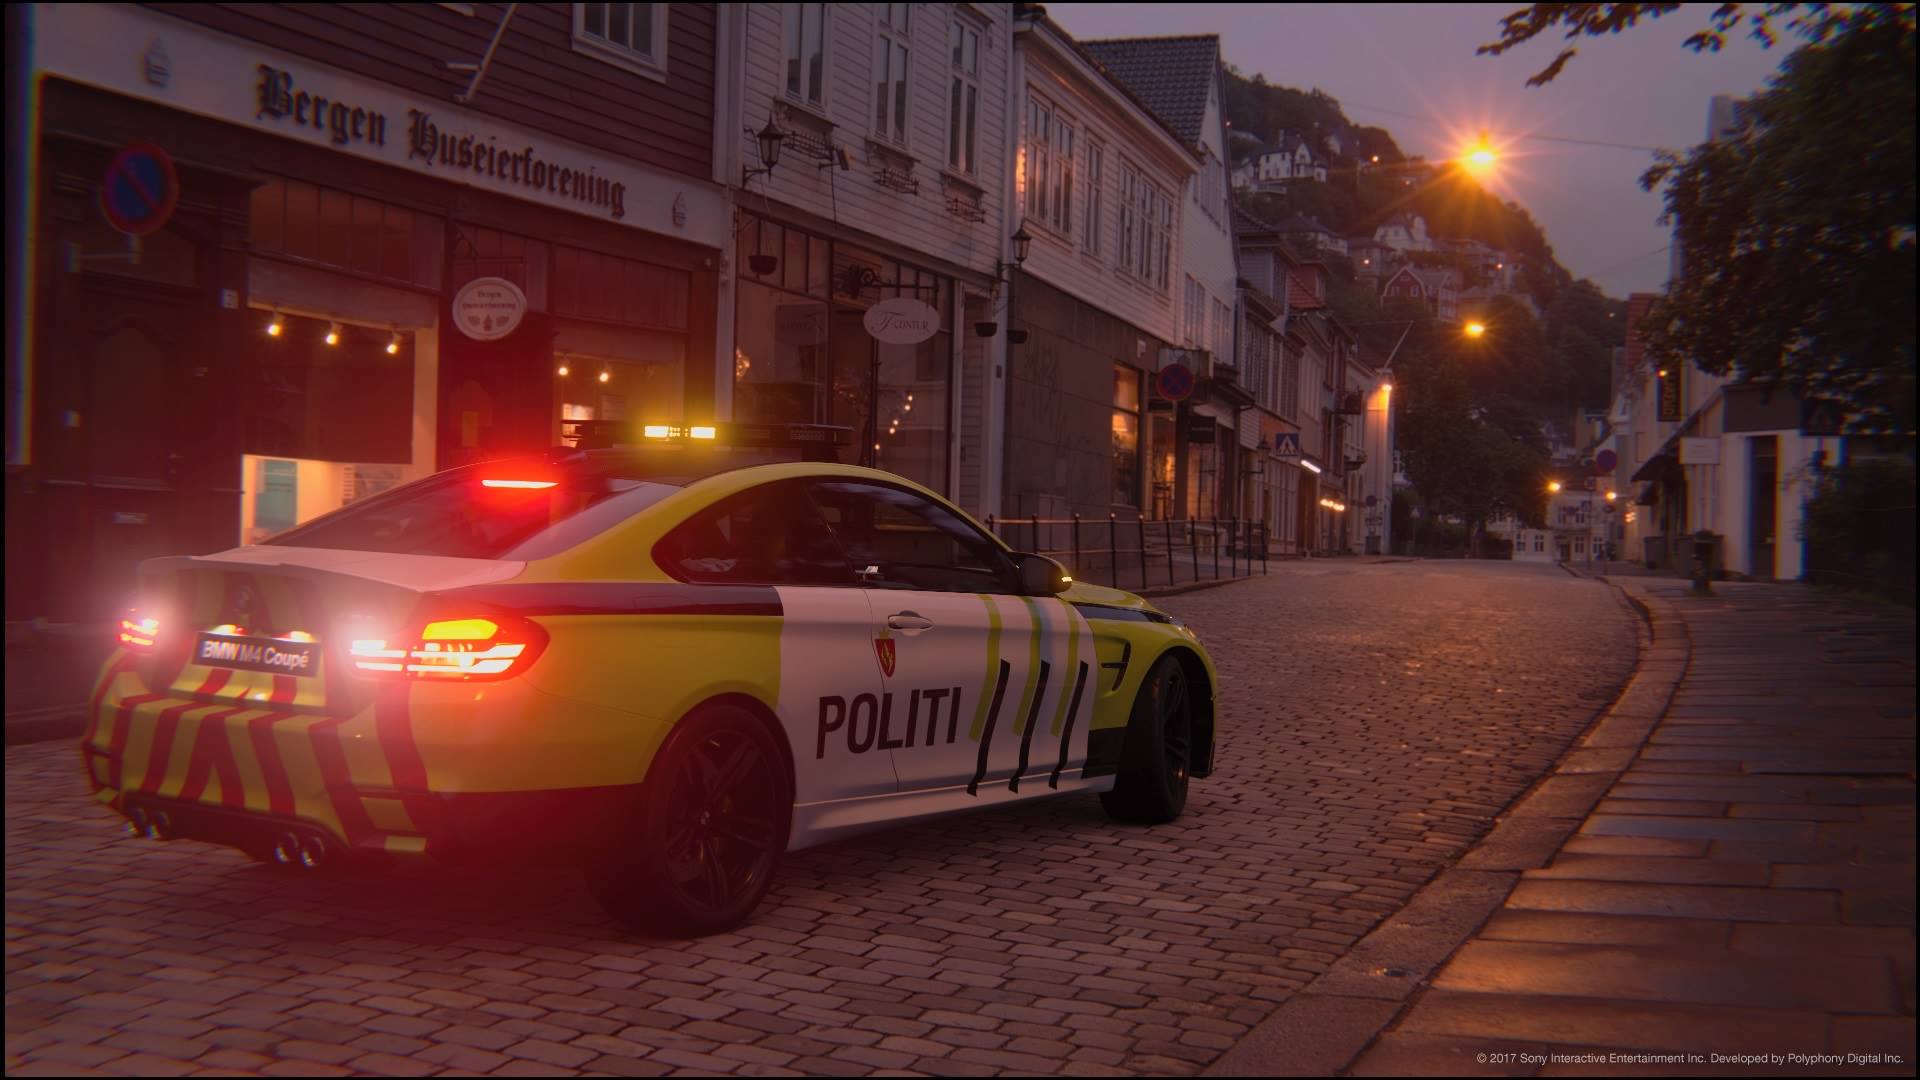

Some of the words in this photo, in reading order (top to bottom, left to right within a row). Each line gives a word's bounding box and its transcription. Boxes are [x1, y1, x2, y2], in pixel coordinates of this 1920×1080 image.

[256, 64, 387, 146] Bergen
[408, 108, 626, 218] Huseierforening
[202, 640, 239, 661] BMW
[240, 643, 263, 663] M4
[264, 646, 310, 671] Coupé
[816, 686, 962, 760] POLITI
